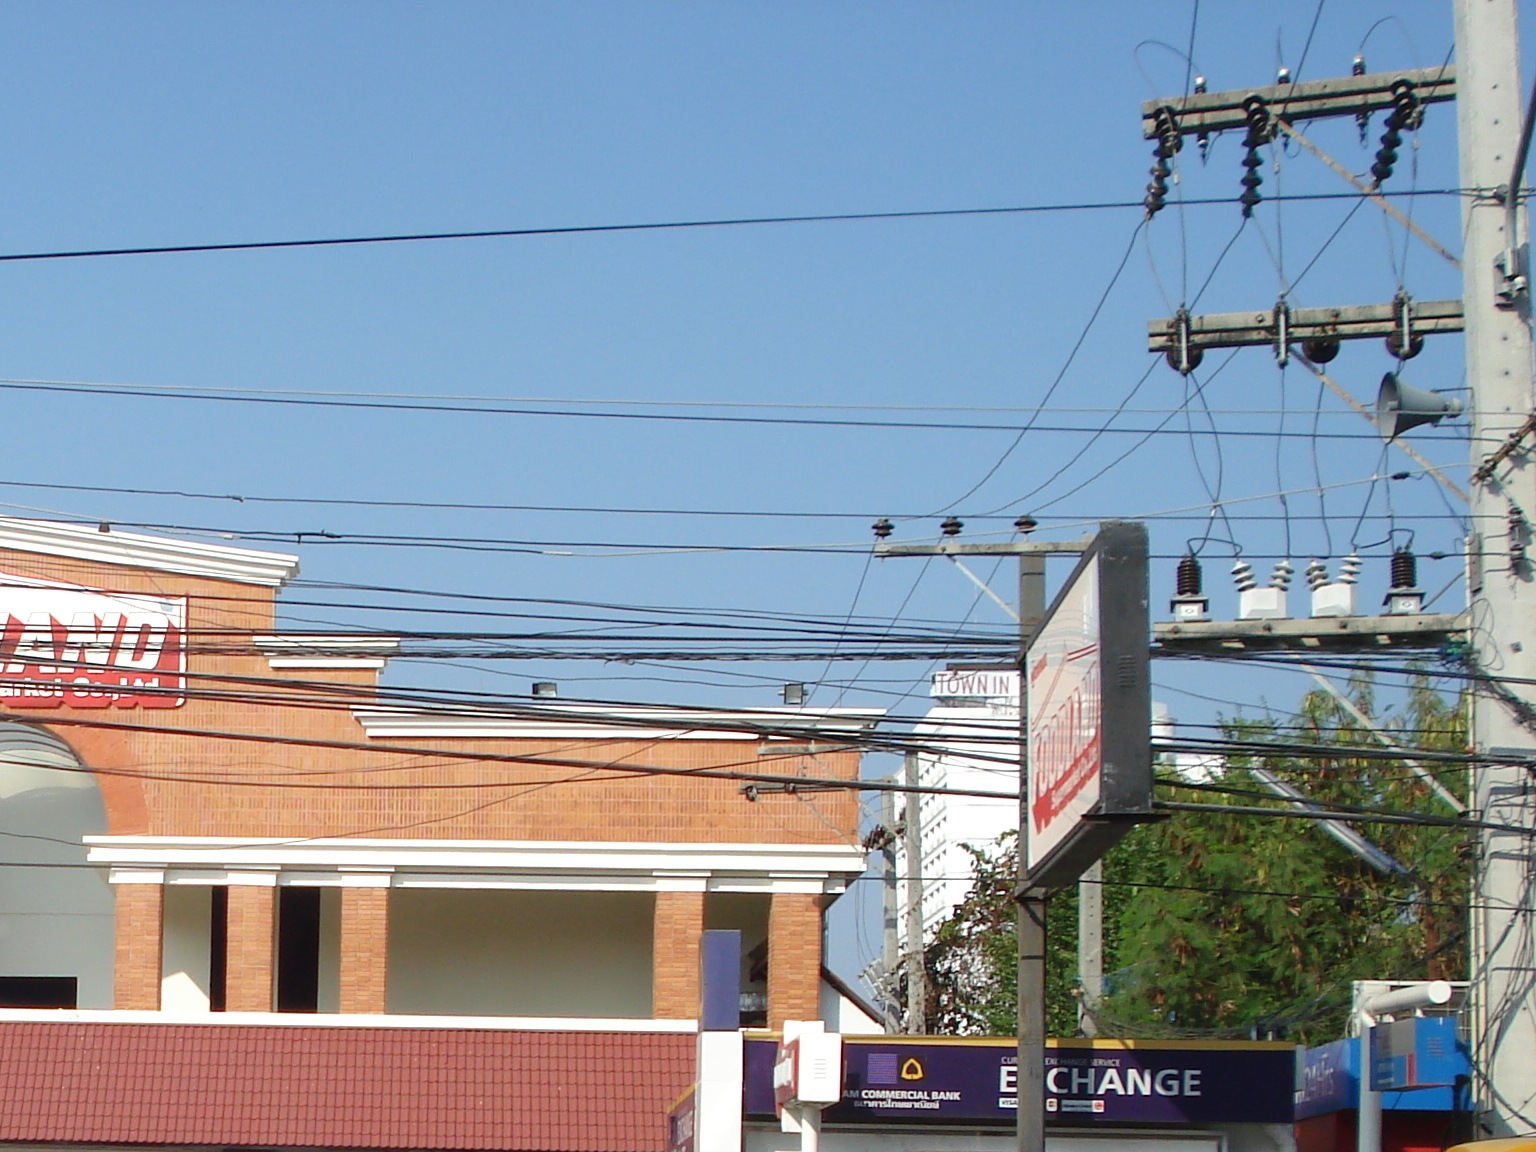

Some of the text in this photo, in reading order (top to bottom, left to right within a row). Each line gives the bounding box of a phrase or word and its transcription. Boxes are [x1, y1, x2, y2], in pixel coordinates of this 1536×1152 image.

[937, 673, 987, 695] TOWN
[993, 675, 1010, 695] IN
[999, 1065, 1202, 1097] ECHANGE
[861, 1089, 930, 1100] COMMERCIAL
[931, 1091, 962, 1101] BANK
